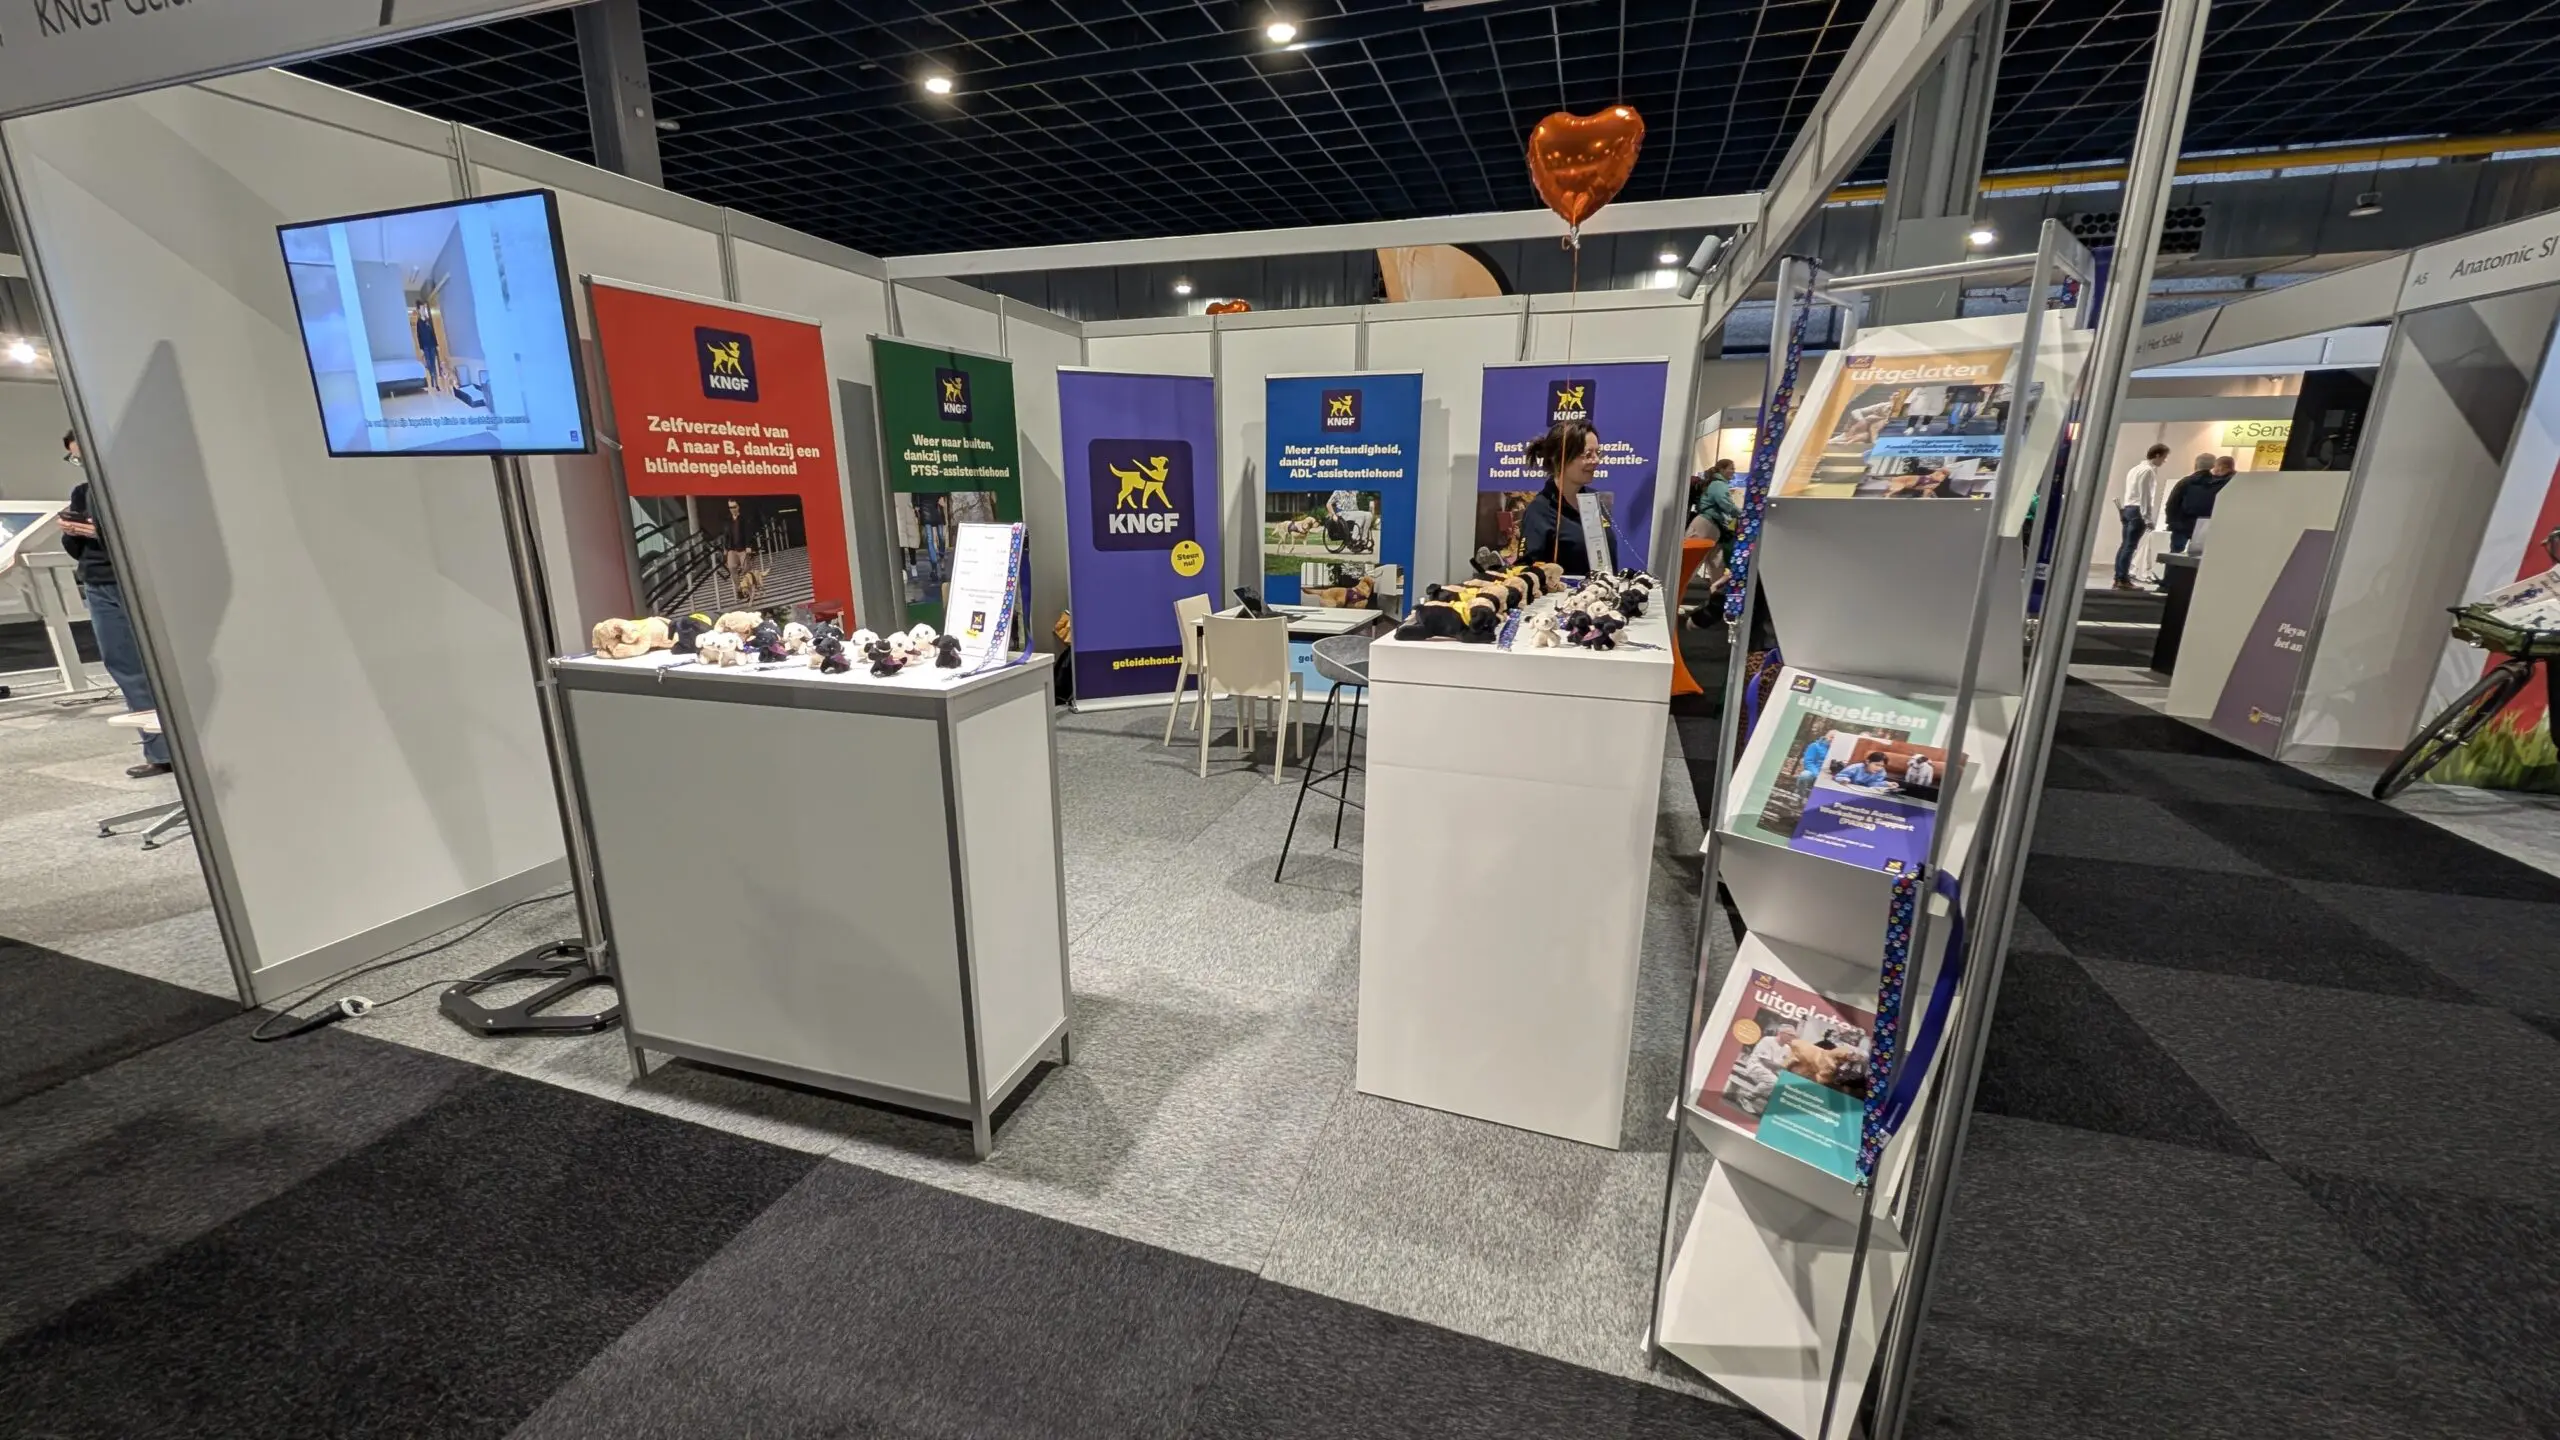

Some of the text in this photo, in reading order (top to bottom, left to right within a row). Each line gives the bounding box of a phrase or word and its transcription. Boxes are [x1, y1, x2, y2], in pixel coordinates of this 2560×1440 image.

[2450, 245, 2534, 280] Anatomic
[1851, 364, 1988, 384] uitgelaten
[709, 374, 750, 391] KNGF
[944, 402, 968, 414] KNGF
[1553, 410, 1587, 421] KNGF
[647, 416, 789, 438] Zelfverzekerd van
[1327, 417, 1356, 426] KNGF
[667, 438, 820, 460] A naar B, dankzij een
[912, 434, 994, 451] Weer naar buiten,
[1285, 444, 1402, 456] Meer zelfstandigheid,
[1494, 442, 1522, 452] Rust
[904, 449, 958, 464] dankzij een
[1279, 457, 1317, 468] dankzij
[644, 458, 797, 477] blindengeleidehond
[911, 464, 1009, 477] PTSS-assistentiehond
[1290, 468, 1403, 478] ADL-assistentiehond
[1490, 468, 1520, 478] hond
[1108, 513, 1180, 534] KNGF
[1112, 655, 1183, 670] geleidehond.n
[1797, 695, 1928, 729] uitgelaten
[1754, 990, 1862, 1034] uitgelate
